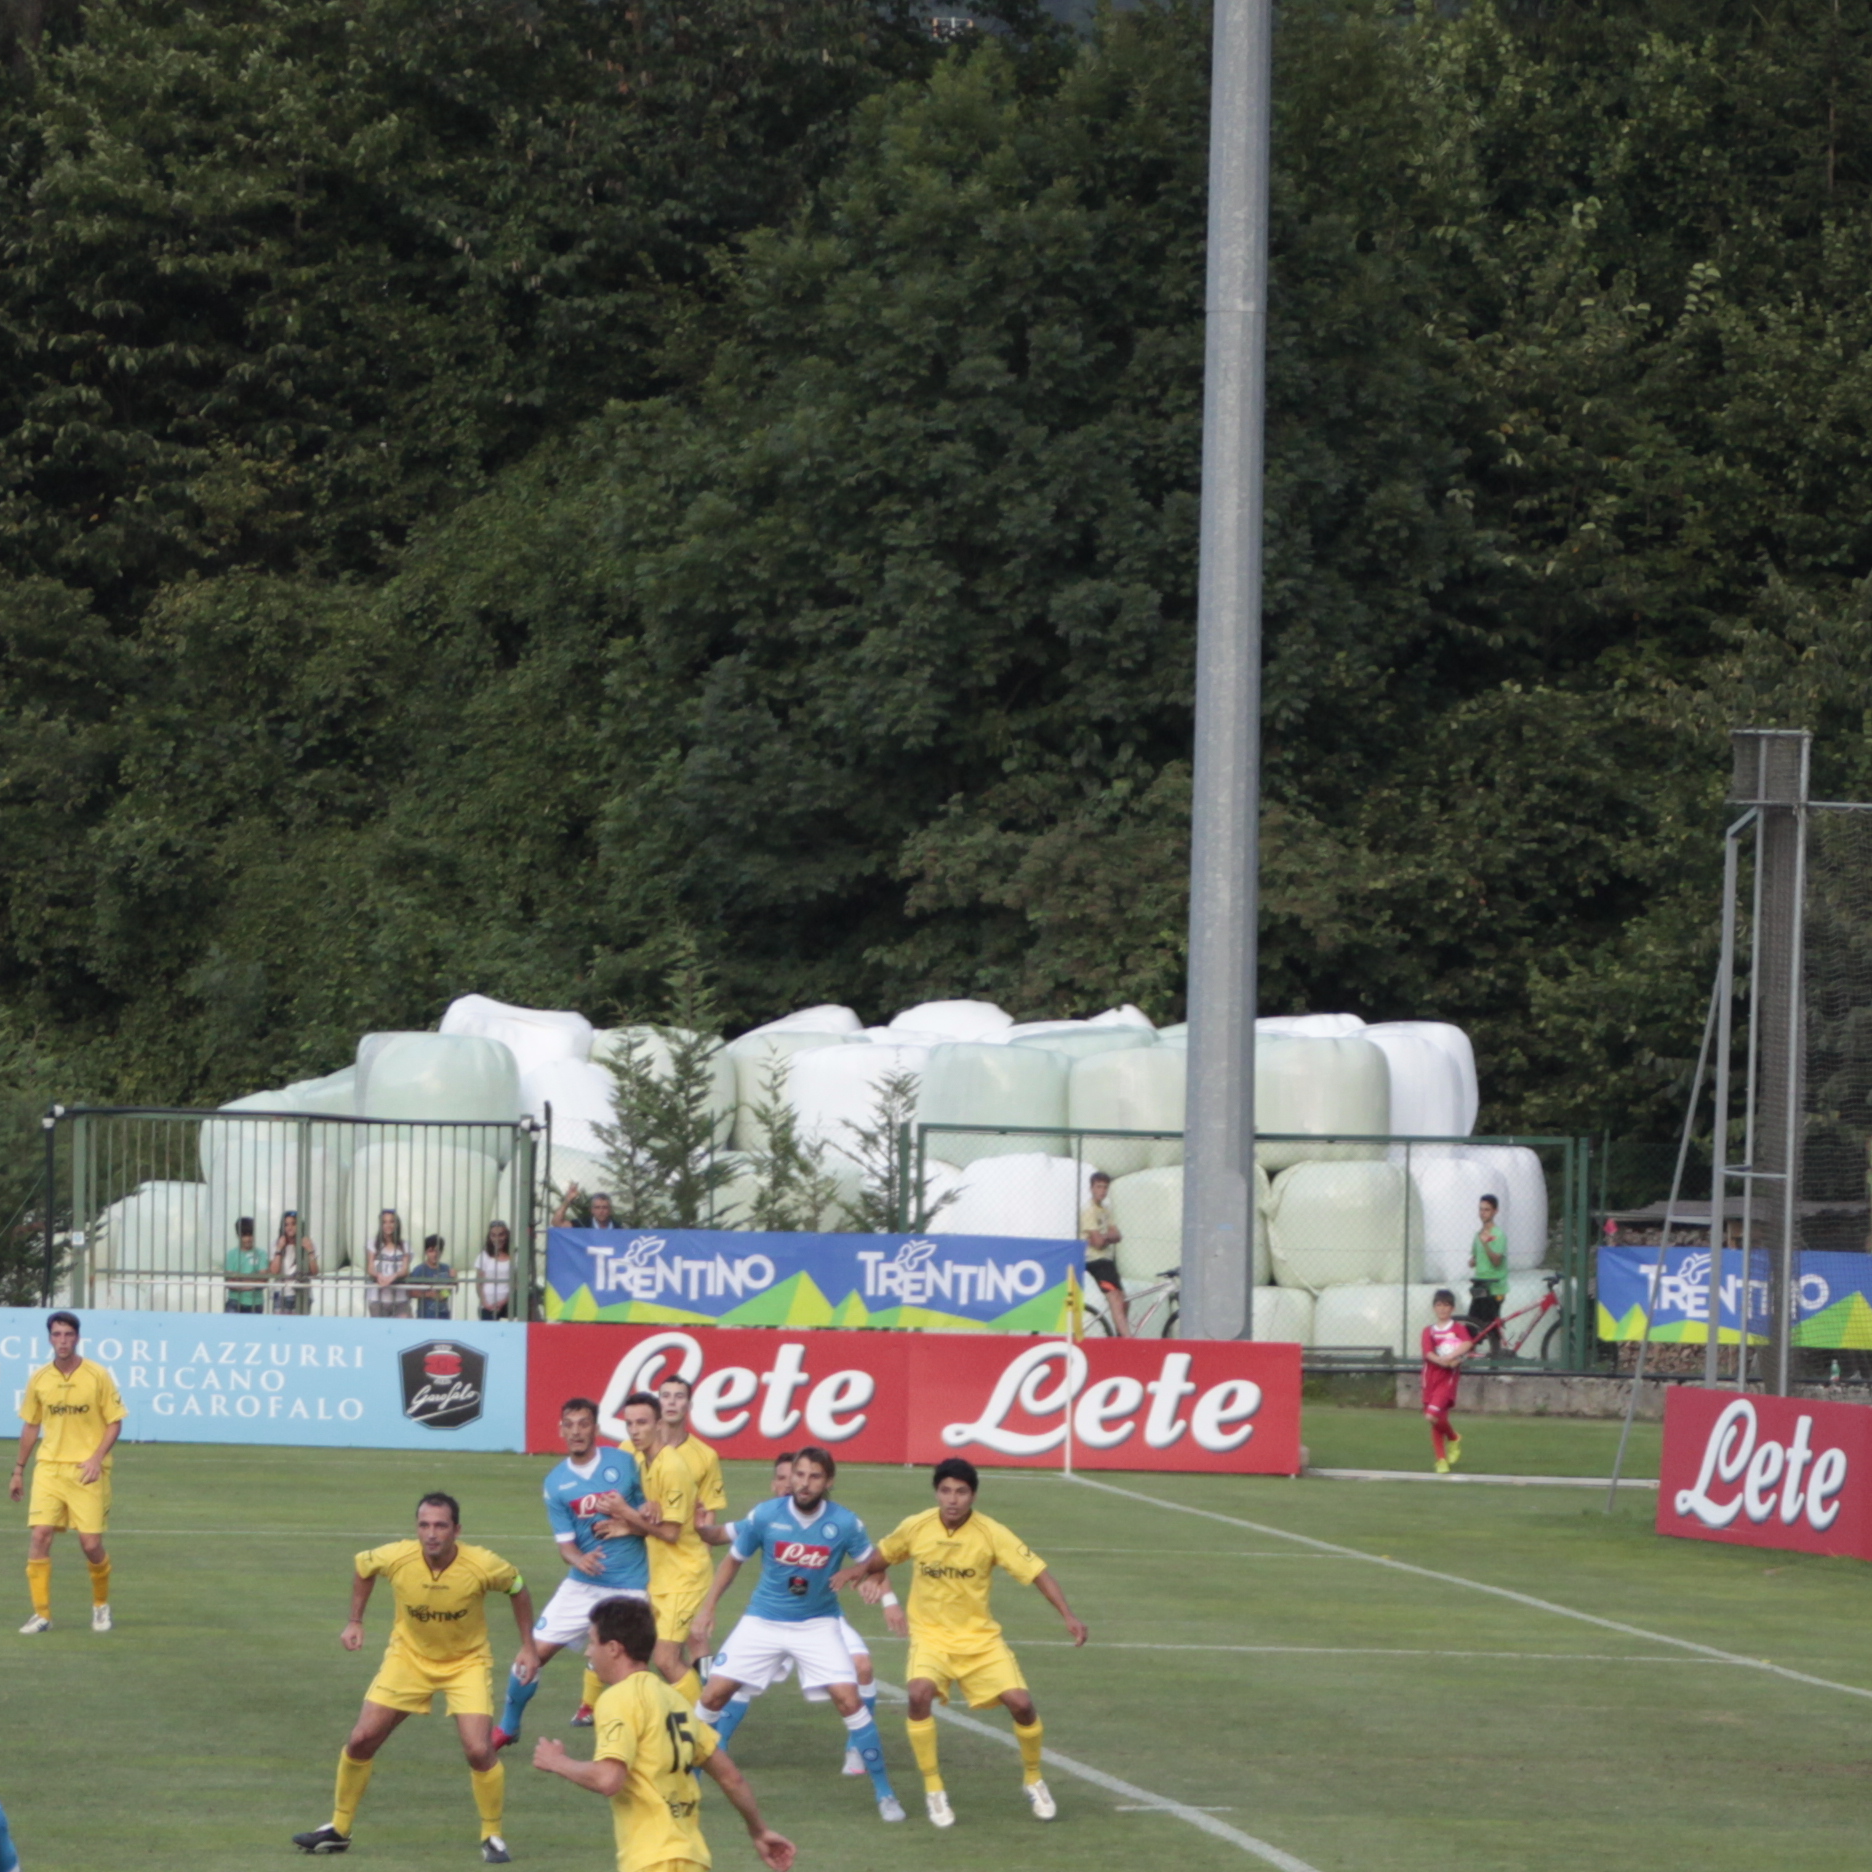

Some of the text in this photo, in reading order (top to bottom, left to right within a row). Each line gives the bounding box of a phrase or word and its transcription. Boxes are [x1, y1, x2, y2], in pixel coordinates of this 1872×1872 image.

[586, 1245, 776, 1301] TRENTINO
[857, 1250, 1046, 1305] TRENTINO
[191, 1341, 365, 1369] AZZURRI
[151, 1392, 365, 1421] GAROFALO
[941, 1341, 1263, 1455] Lete
[1674, 1398, 1847, 1531] Lete
[775, 1542, 830, 1568] Lete
[665, 1711, 696, 1774] 15
